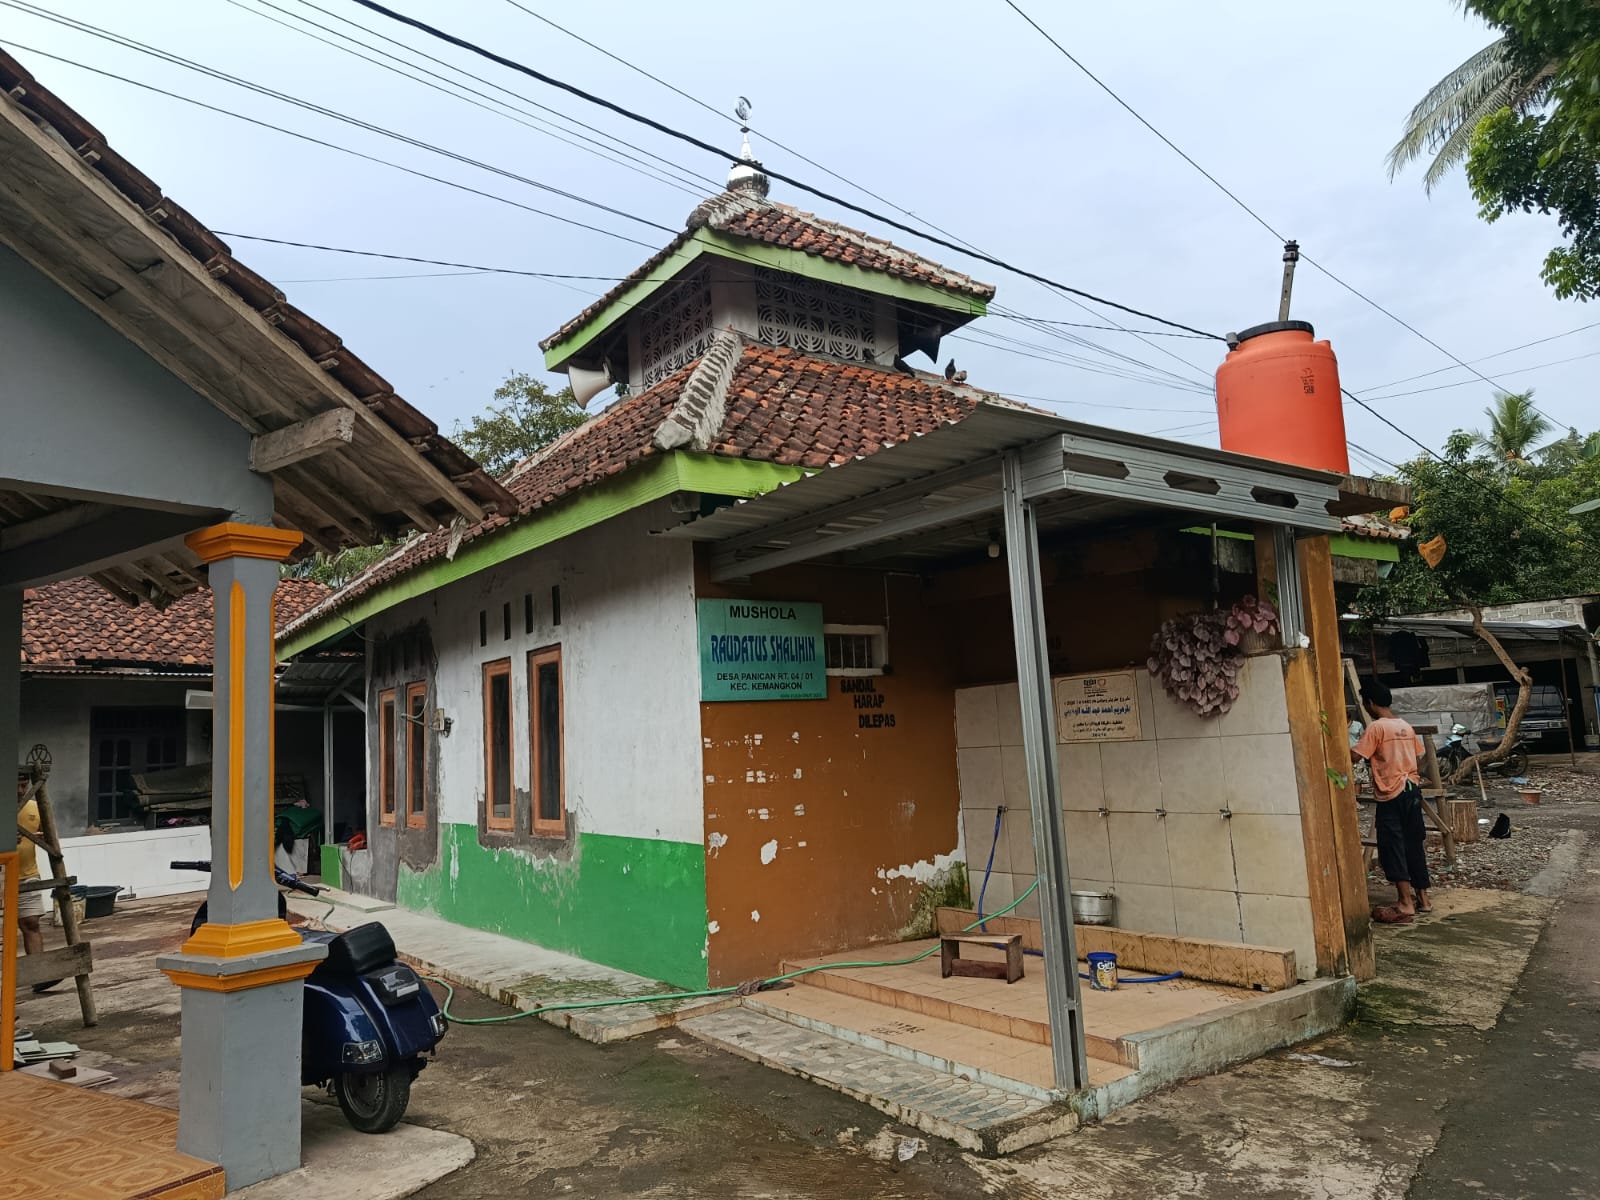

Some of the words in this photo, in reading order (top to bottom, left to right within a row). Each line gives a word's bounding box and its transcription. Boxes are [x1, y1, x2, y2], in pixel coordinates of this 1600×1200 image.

[729, 605, 797, 620] MUSHOLA
[711, 634, 768, 664] RAUDATUS
[769, 635, 816, 664] SHALIHIN
[717, 672, 740, 681] DESA
[741, 672, 776, 681] PANICAN
[751, 682, 802, 690] KEMANGKON
[840, 679, 876, 693] SANDAL
[854, 694, 885, 709] HARAP
[858, 714, 896, 728] DILEPAS
